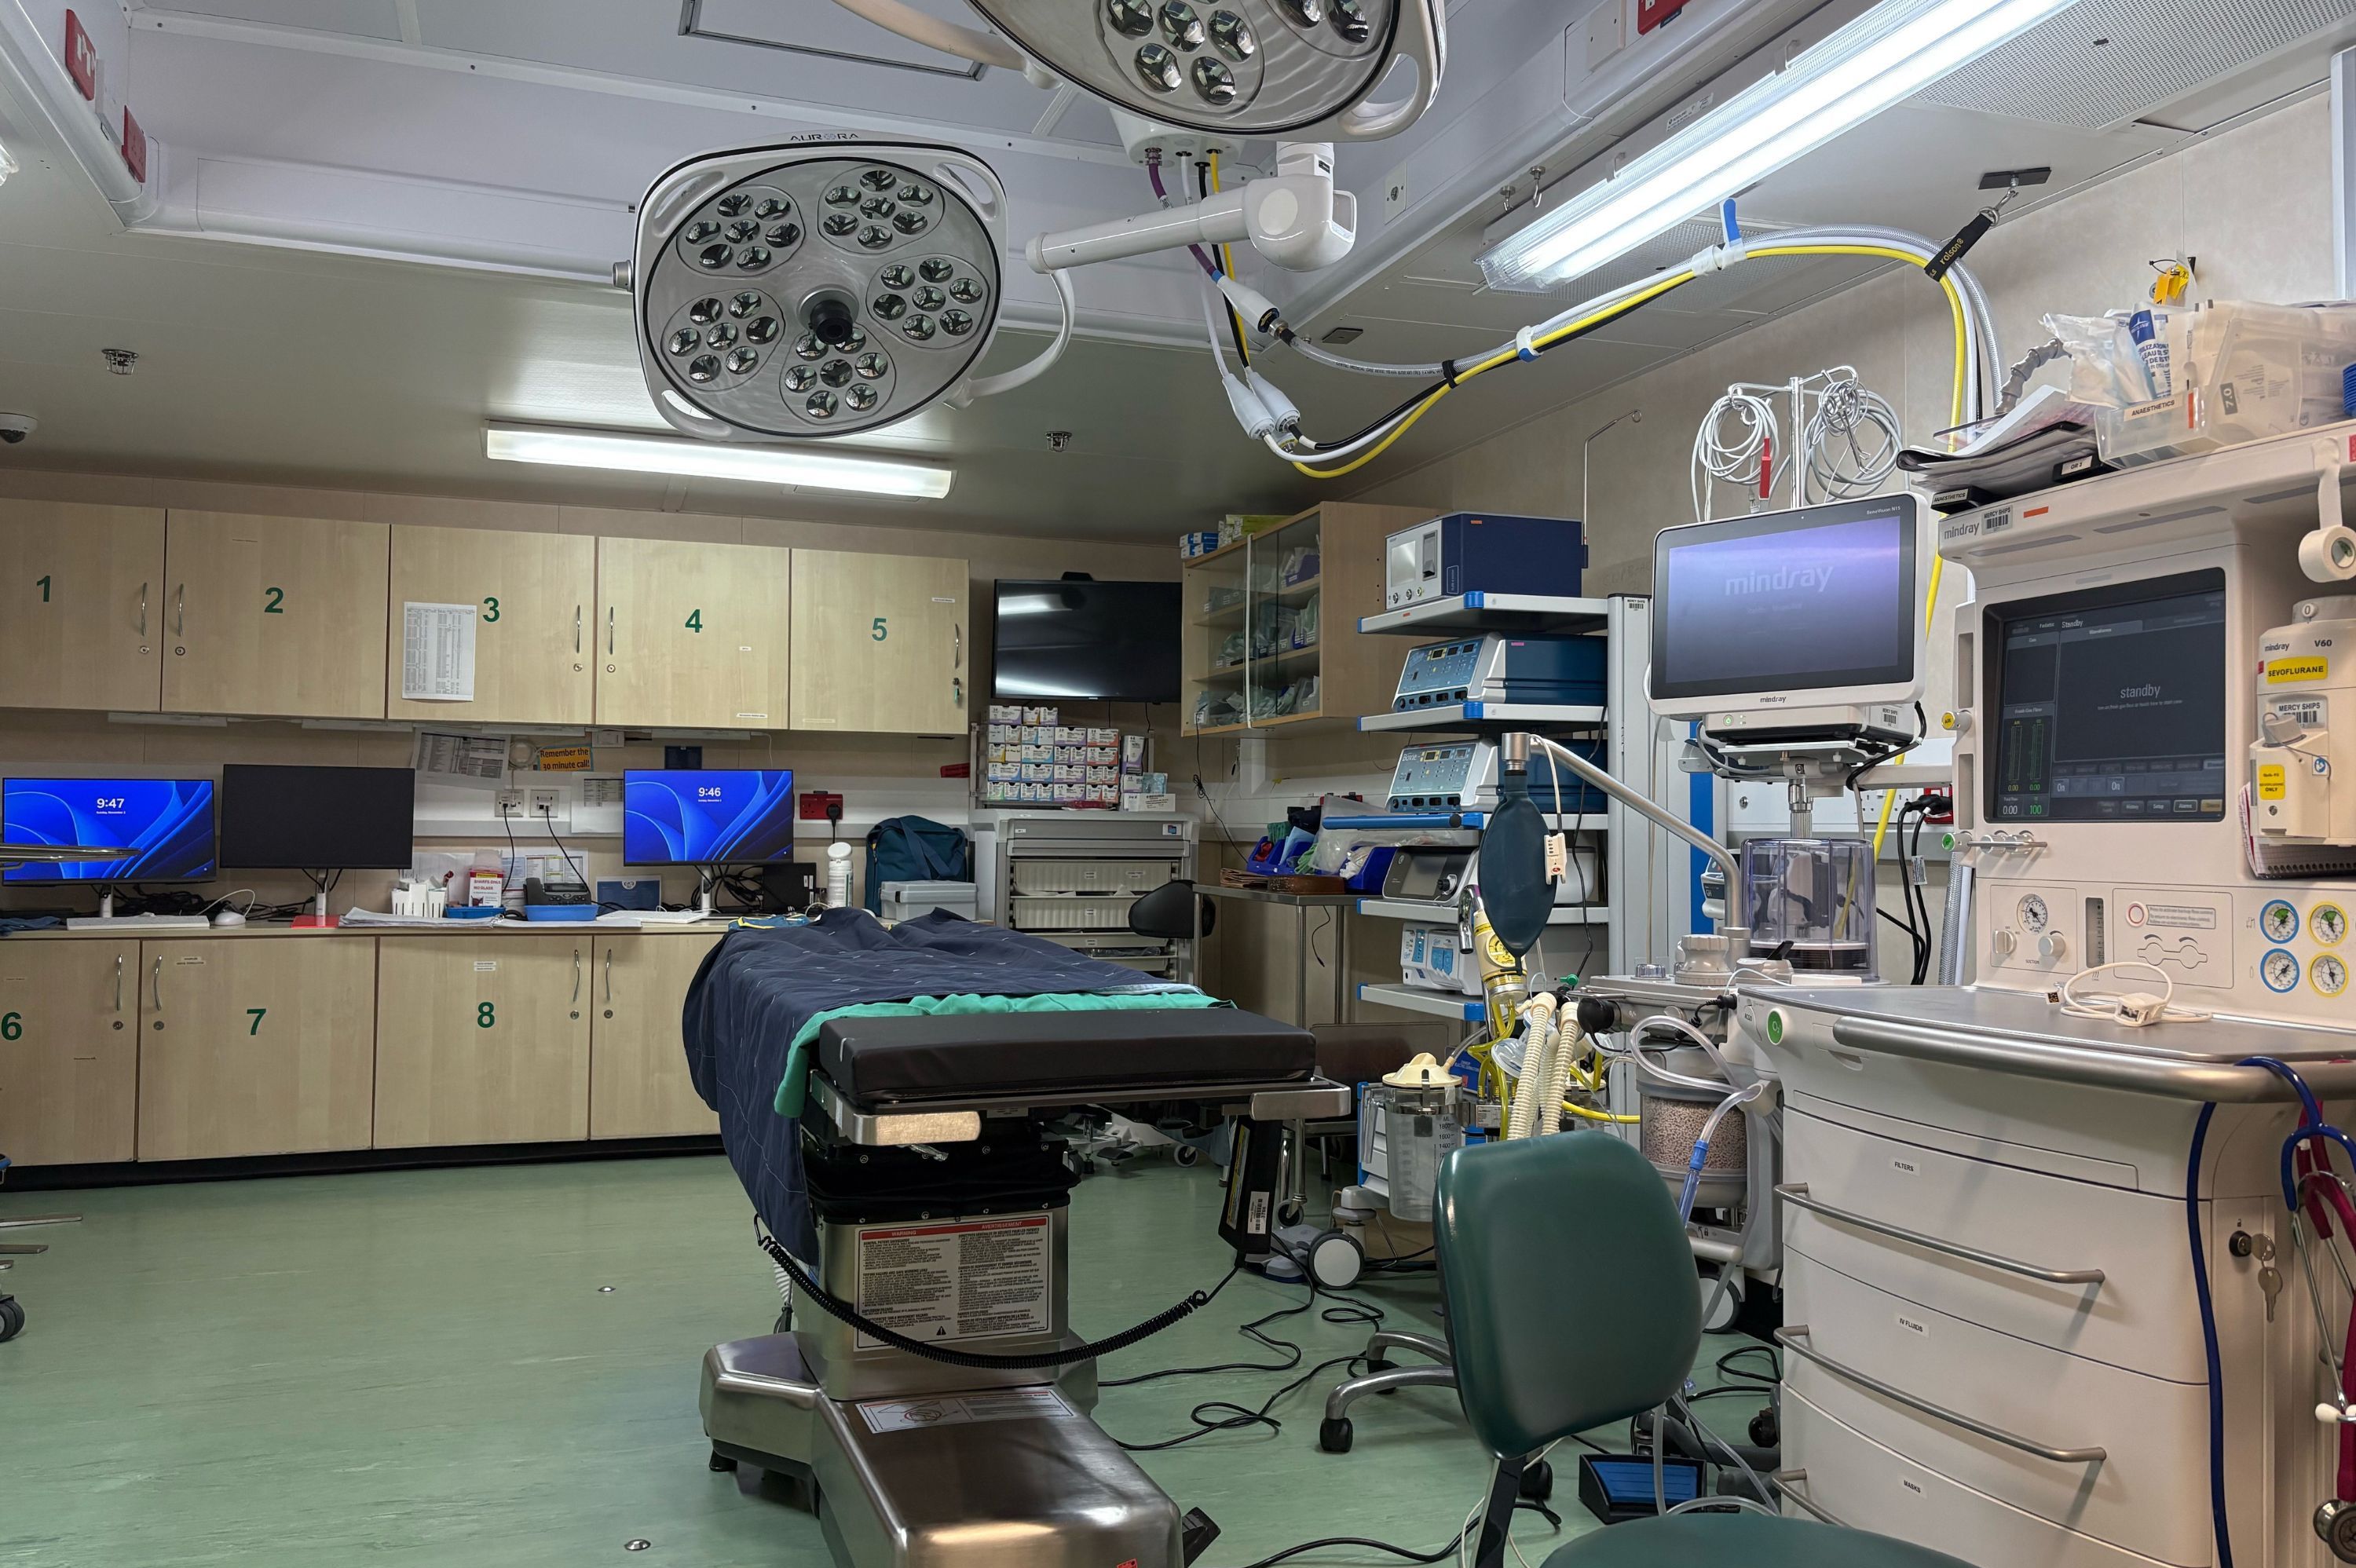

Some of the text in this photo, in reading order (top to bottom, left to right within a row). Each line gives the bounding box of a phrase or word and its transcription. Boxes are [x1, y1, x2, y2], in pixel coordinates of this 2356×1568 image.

[2223, 387, 2234, 408] 7.0
[2131, 399, 2175, 416] ANAESTHETICS
[1933, 492, 1966, 503] ANAESTHETICS
[1984, 506, 2011, 518] MERCY SHIPS
[1944, 522, 1980, 539] mindray
[1725, 565, 1834, 596] mindray
[36, 576, 51, 602] 1
[263, 587, 284, 613] 2
[482, 597, 500, 623] 3
[685, 609, 703, 633] 4
[2062, 619, 2083, 628] Standby
[871, 618, 887, 641] 5
[2265, 642, 2290, 652] mindray
[2268, 665, 2324, 677] SEVOFLURANE
[2120, 683, 2160, 698] standby
[540, 749, 576, 758] Remember
[552, 761, 576, 770] minute
[576, 759, 590, 768] call!
[699, 787, 721, 797] 9:46
[2058, 783, 2065, 792] On
[2111, 781, 2120, 791] On
[97, 798, 125, 809] 9:47
[2003, 806, 2018, 814] 0.00
[2030, 805, 2042, 814] 100
[246, 1008, 267, 1036] 7
[477, 1002, 496, 1029] 8
[1, 1011, 22, 1040] 6
[1894, 1161, 1914, 1171] FILTERS
[1905, 1320, 1923, 1332] FLUIDS
[1904, 1479, 1921, 1493] MASKS
